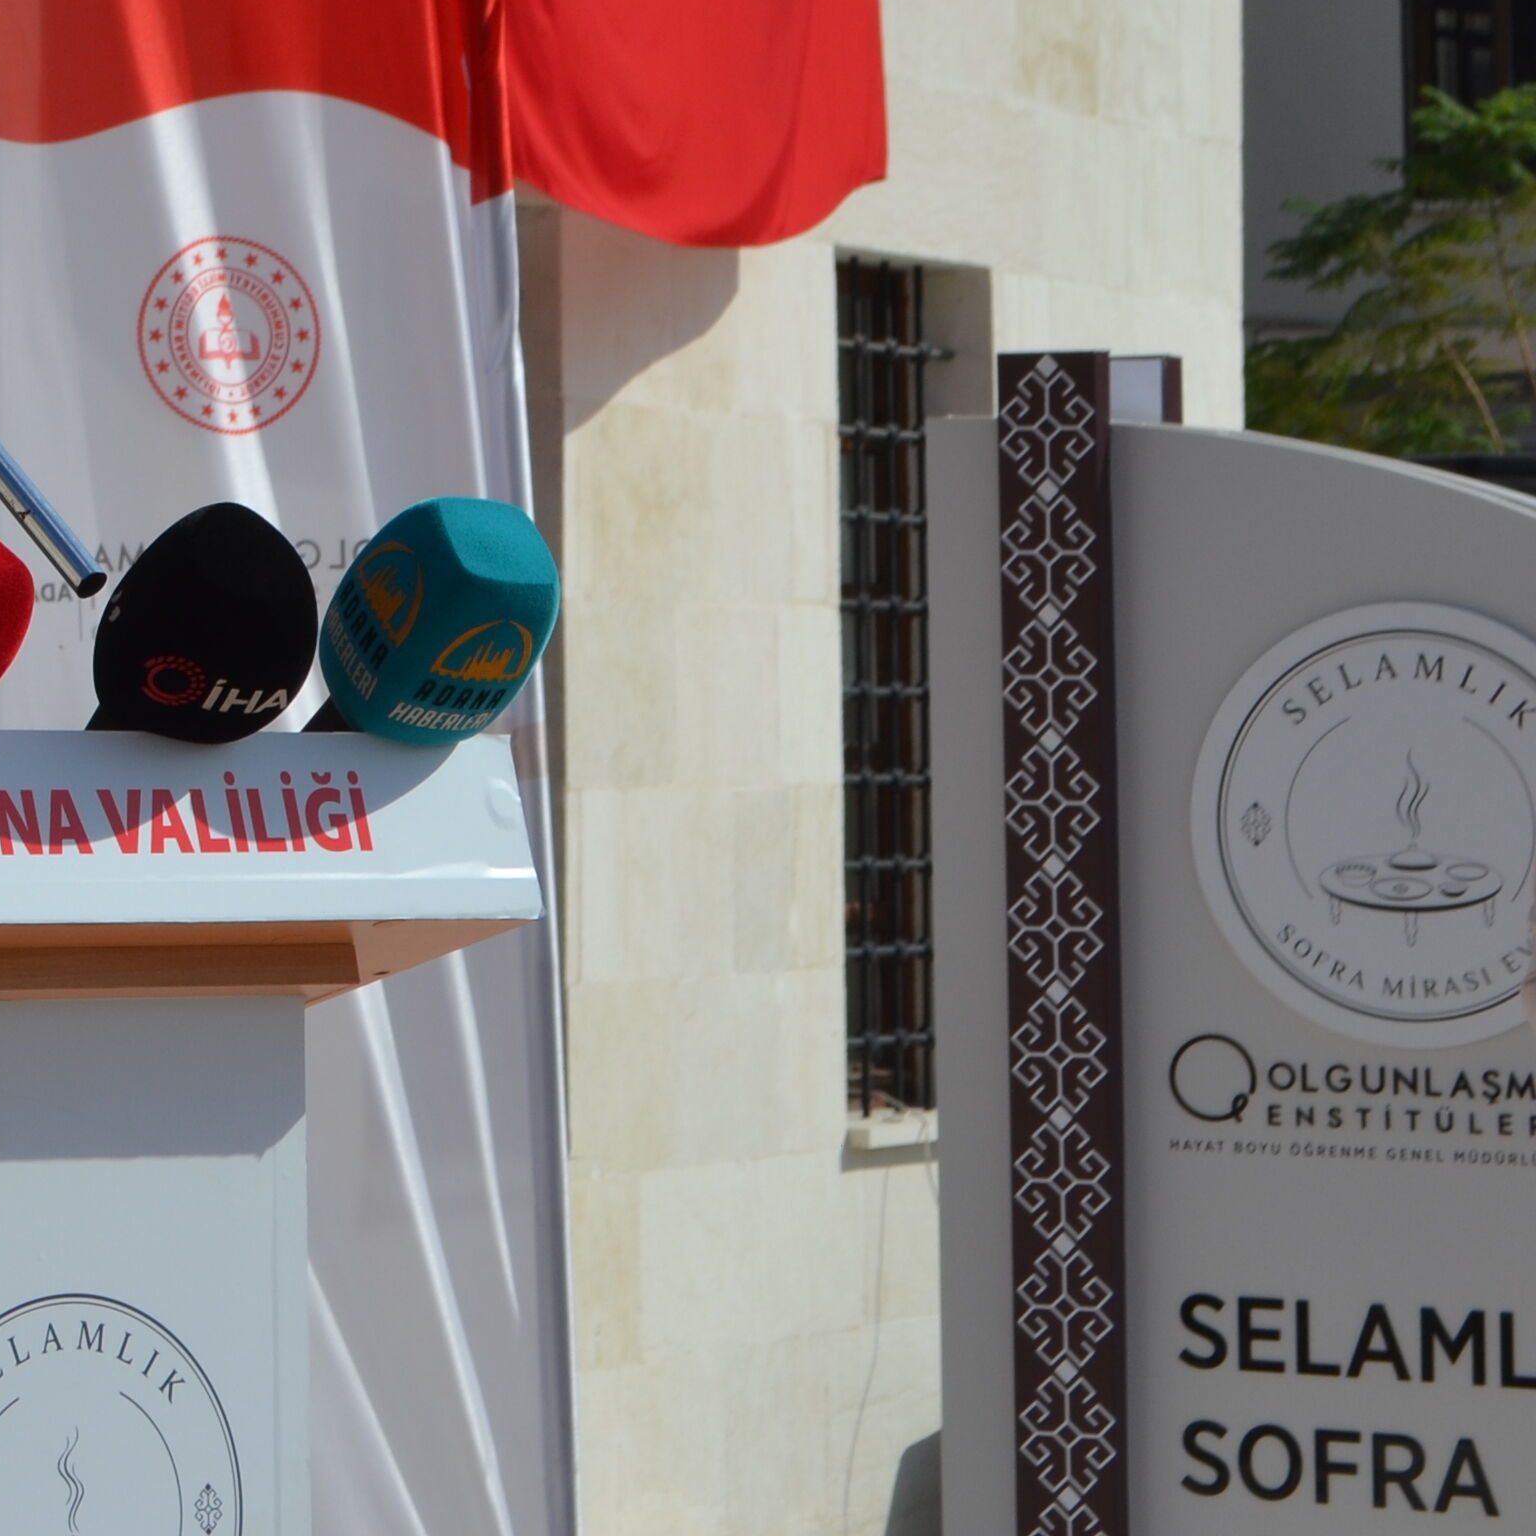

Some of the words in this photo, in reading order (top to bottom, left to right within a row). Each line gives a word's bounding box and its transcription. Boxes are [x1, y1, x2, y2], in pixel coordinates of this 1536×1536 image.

[201, 678, 289, 715] İHA
[412, 679, 507, 711] ADANA
[1281, 651, 1536, 731] SELAMLIK
[95, 769, 375, 856] VALİLİĞİ
[1276, 922, 1366, 990] SOFRA
[1381, 966, 1493, 1000] MİRASI
[1267, 1061, 1536, 1106] OLGUNLAŞM
[1169, 1138, 1225, 1154] HAYAT
[1233, 1141, 1282, 1156] BOYU
[1289, 1140, 1378, 1160] ÖĞRENME
[1385, 1147, 1444, 1164] GENEL
[1180, 1419, 1501, 1518] SOFRA
